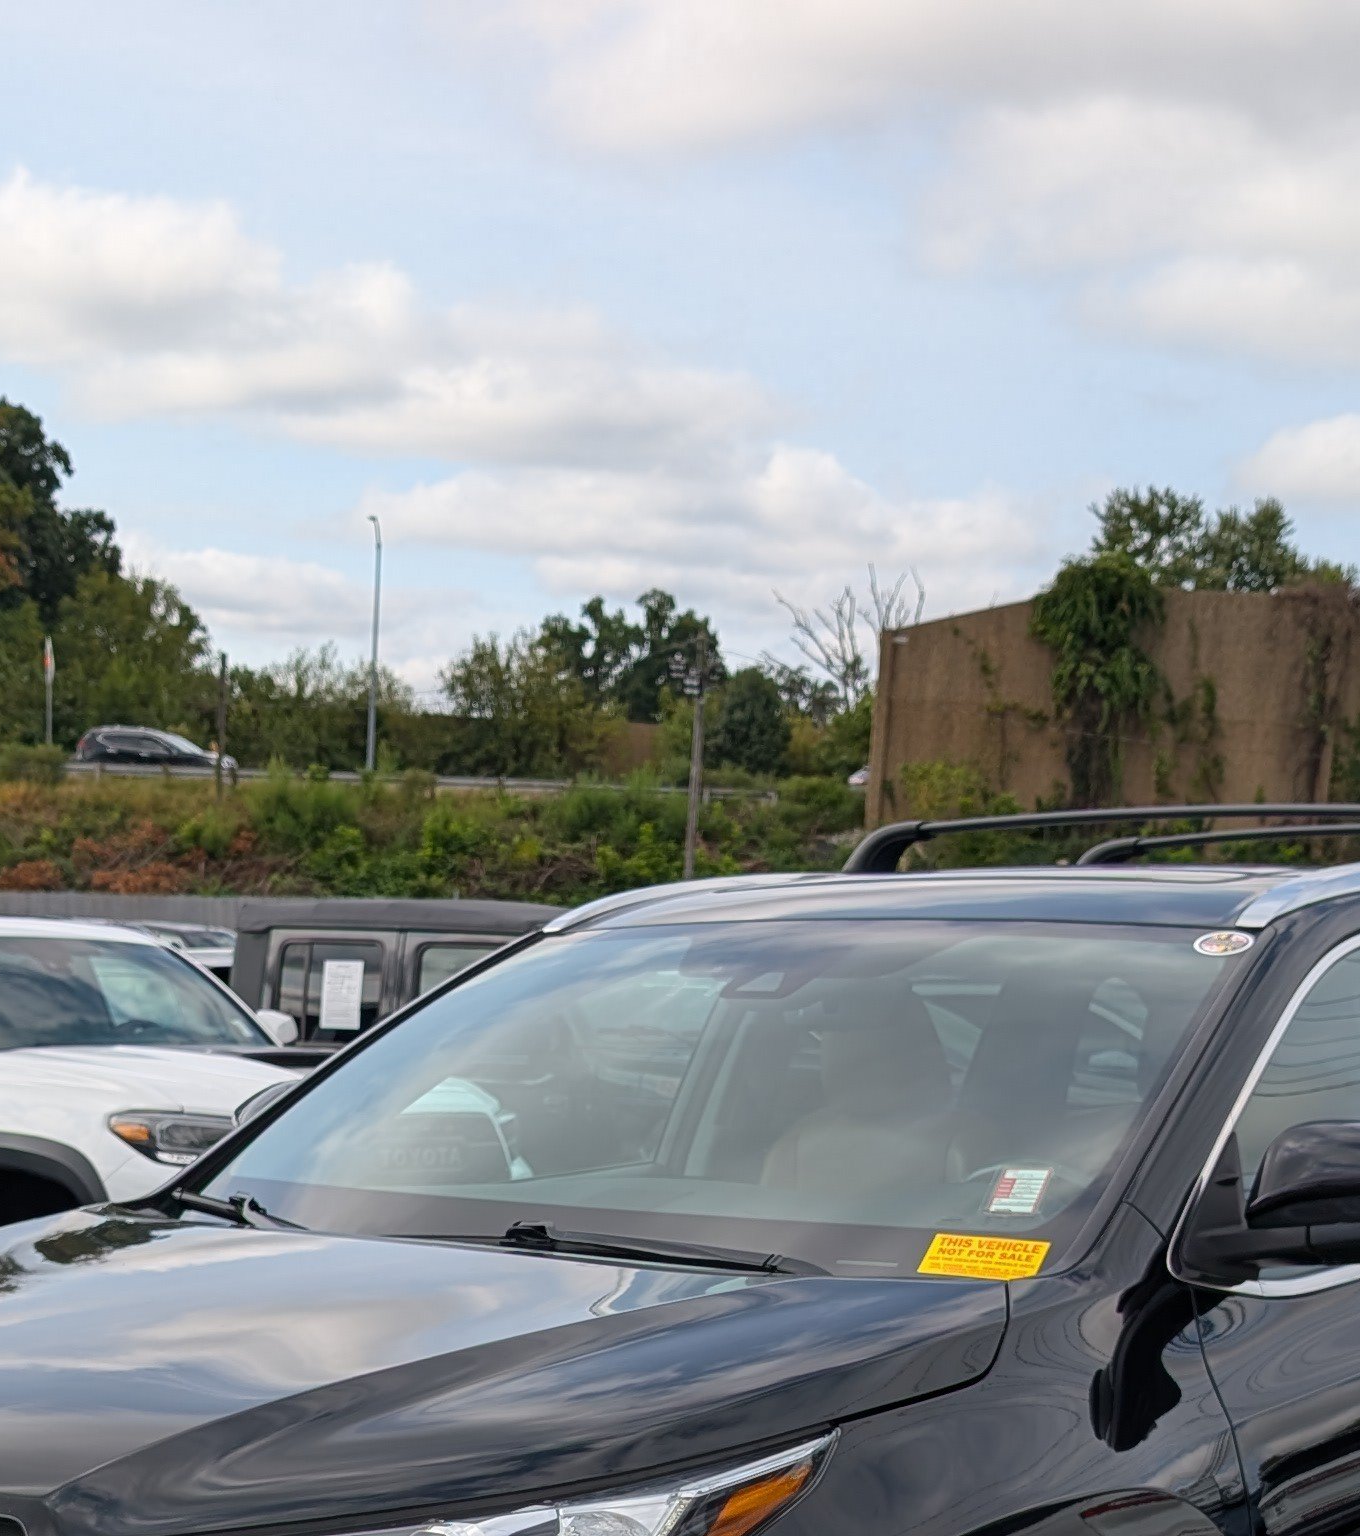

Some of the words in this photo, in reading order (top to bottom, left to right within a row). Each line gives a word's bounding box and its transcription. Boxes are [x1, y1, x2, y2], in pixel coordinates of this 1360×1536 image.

[378, 1145, 463, 1169] TOYOTA
[939, 1237, 973, 1249] THIS
[977, 1239, 1043, 1254] VEHICLE
[937, 1247, 965, 1257] NOT
[967, 1249, 995, 1259] FOR
[999, 1252, 1035, 1263] SALE
